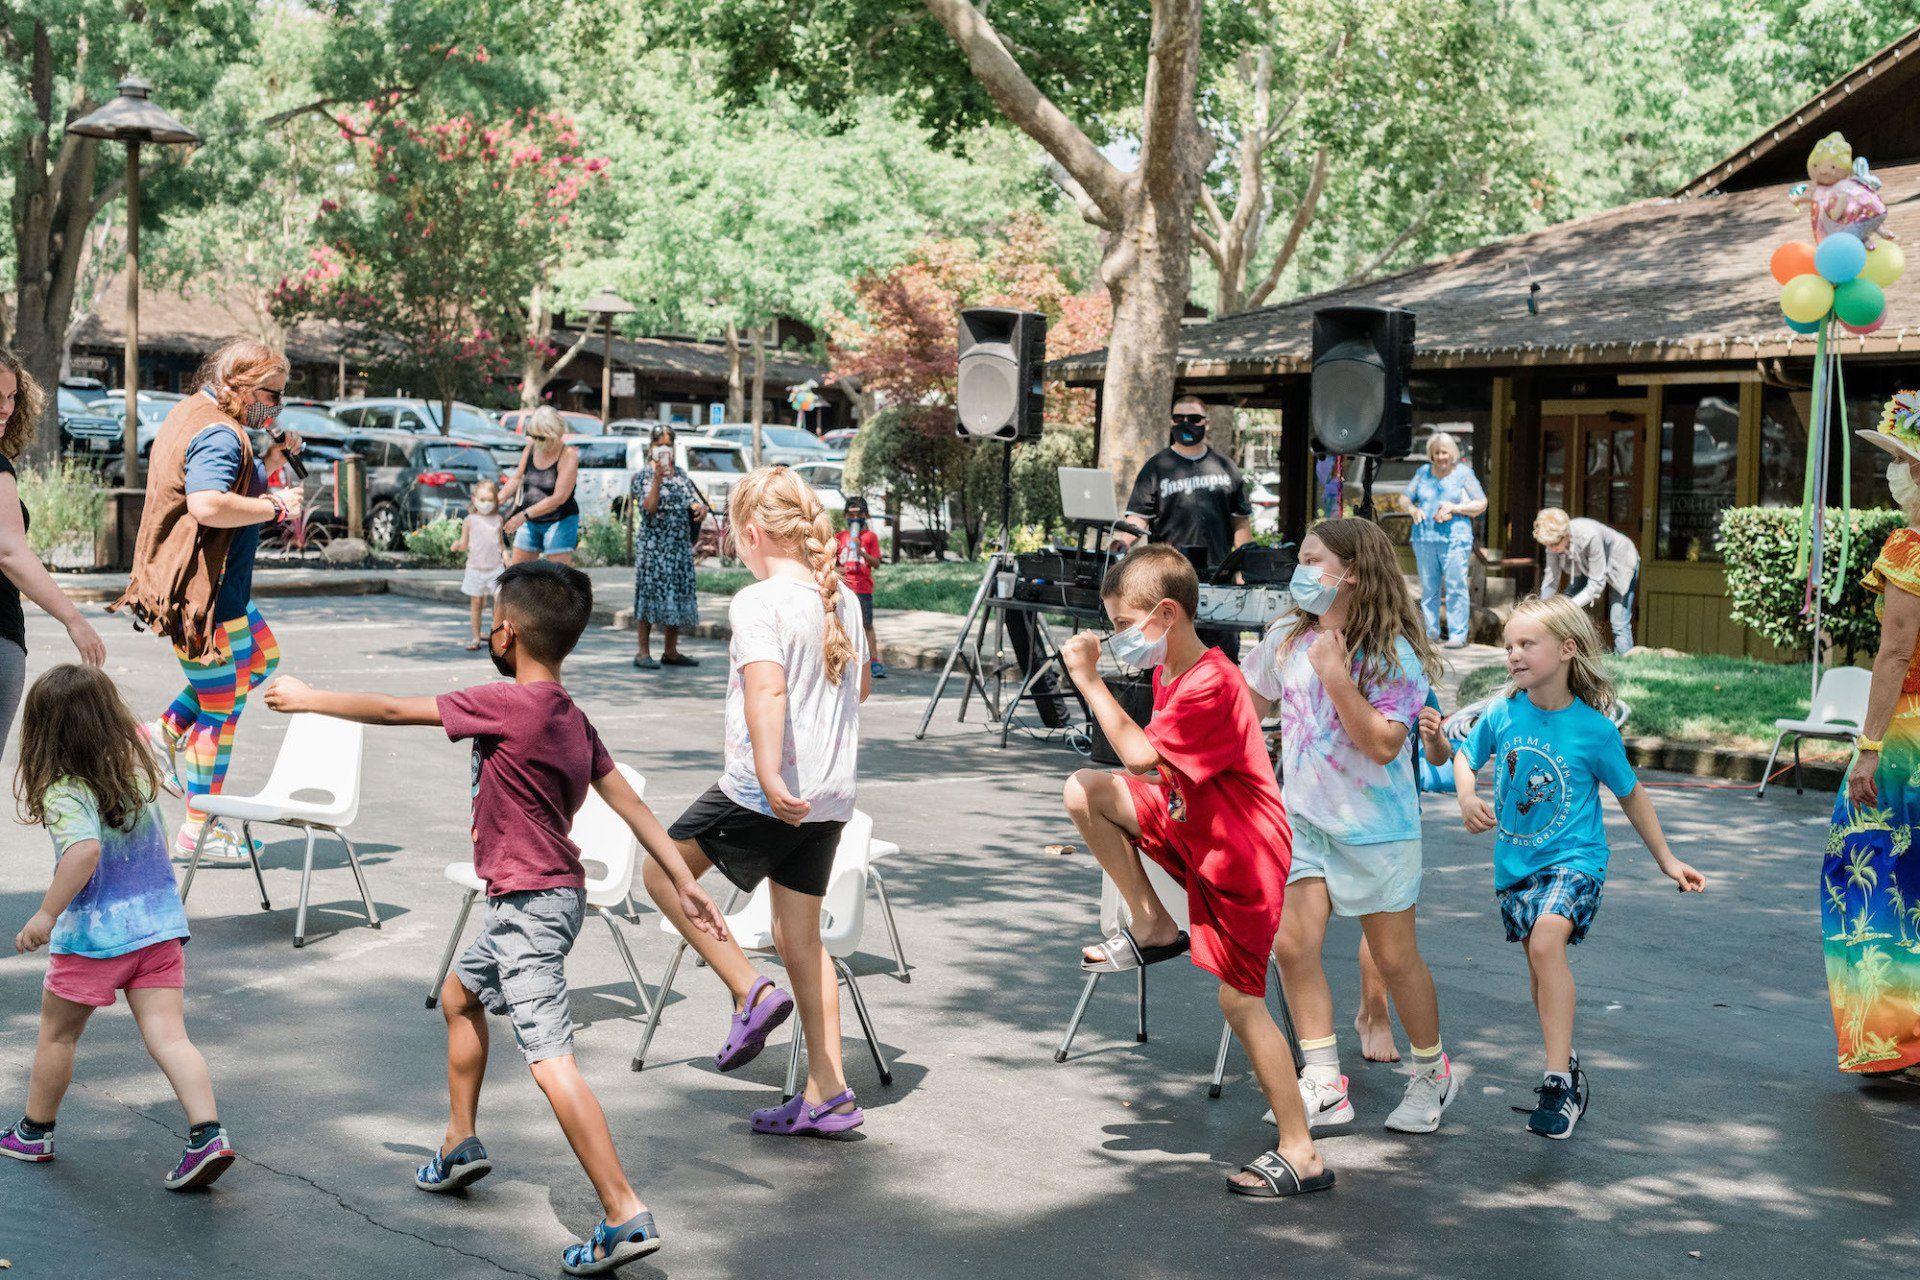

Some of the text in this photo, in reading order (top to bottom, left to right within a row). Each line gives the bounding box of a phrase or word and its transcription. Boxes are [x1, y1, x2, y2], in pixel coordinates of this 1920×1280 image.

[1160, 474, 1232, 498] Insynapse
[1555, 756, 1571, 779] GYM
[1556, 787, 1573, 827] TURKEY
